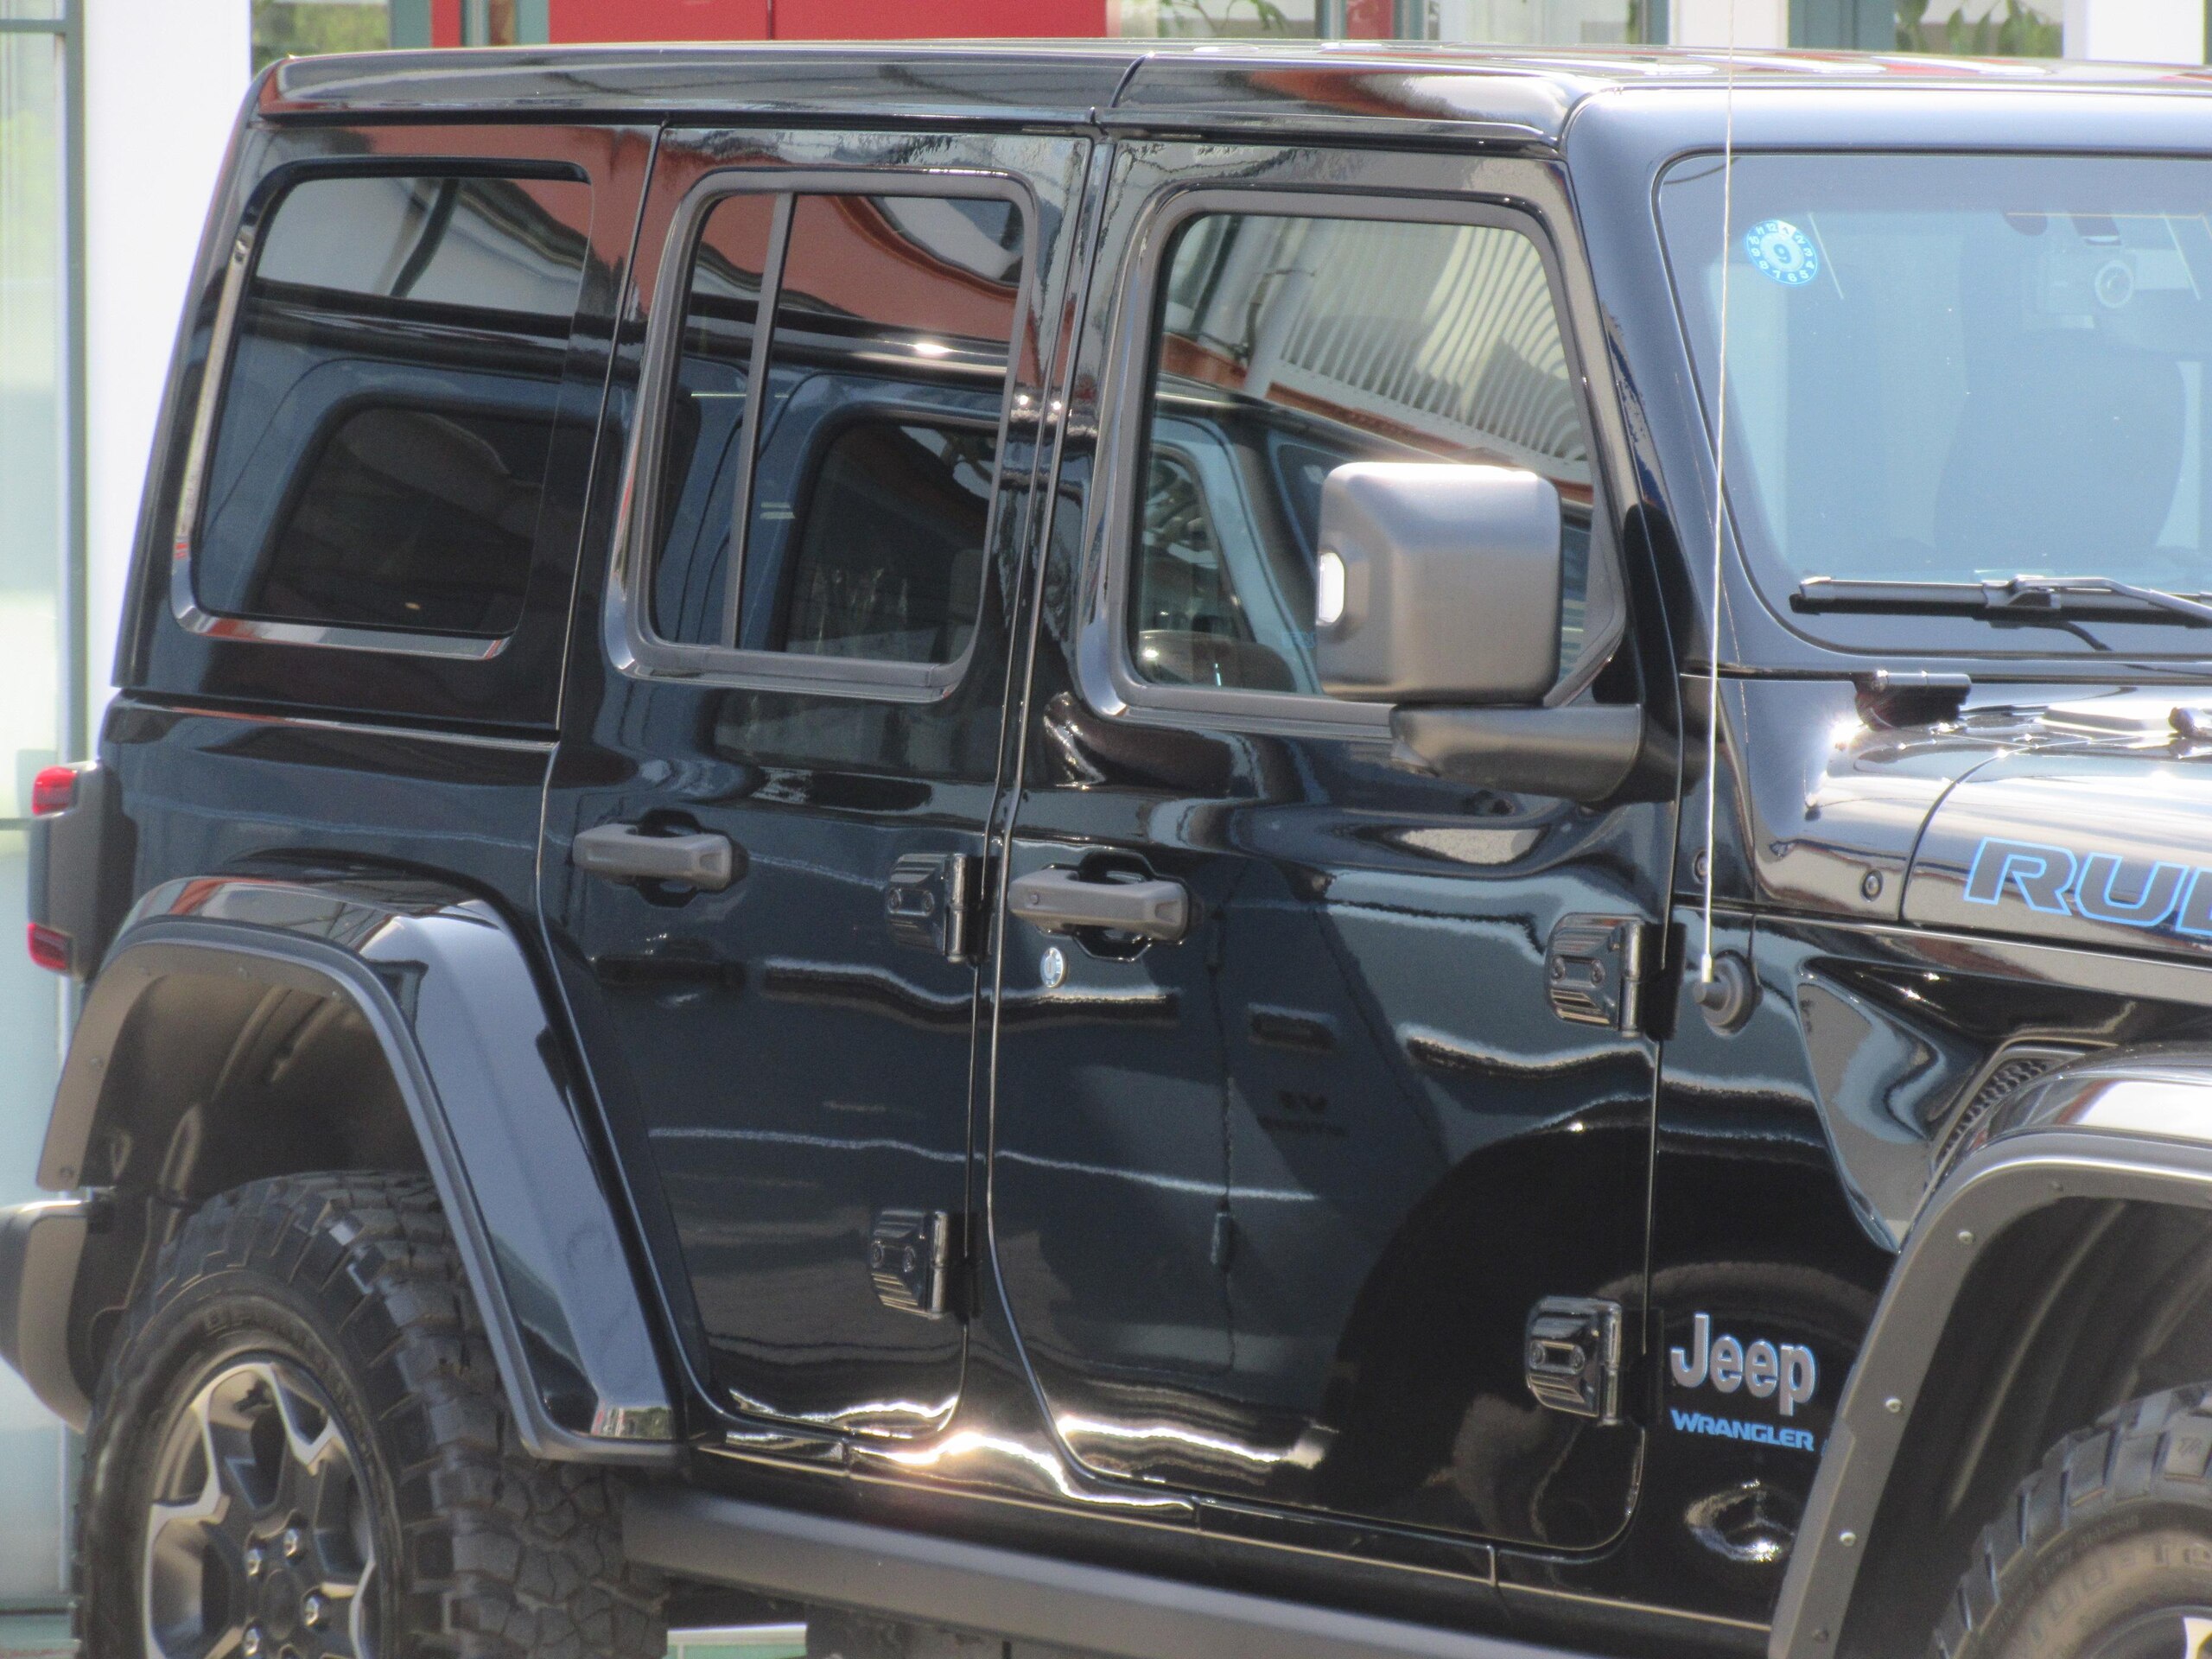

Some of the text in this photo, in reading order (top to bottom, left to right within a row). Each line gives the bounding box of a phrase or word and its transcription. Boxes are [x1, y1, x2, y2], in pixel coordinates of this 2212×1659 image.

[1765, 222, 1777, 232] 12
[1795, 234, 1806, 244] 2
[1751, 247, 1761, 257] 9
[1773, 243, 1793, 264] 9
[1802, 247, 1814, 257] 3
[1758, 260, 1770, 270] 8
[1805, 260, 1815, 270] 4
[1772, 270, 1781, 279] 7
[1787, 272, 1798, 283] 6
[1798, 270, 1809, 279] 5
[1670, 1312, 1816, 1417] Jeep
[1669, 1408, 1815, 1452] WRANGLER
